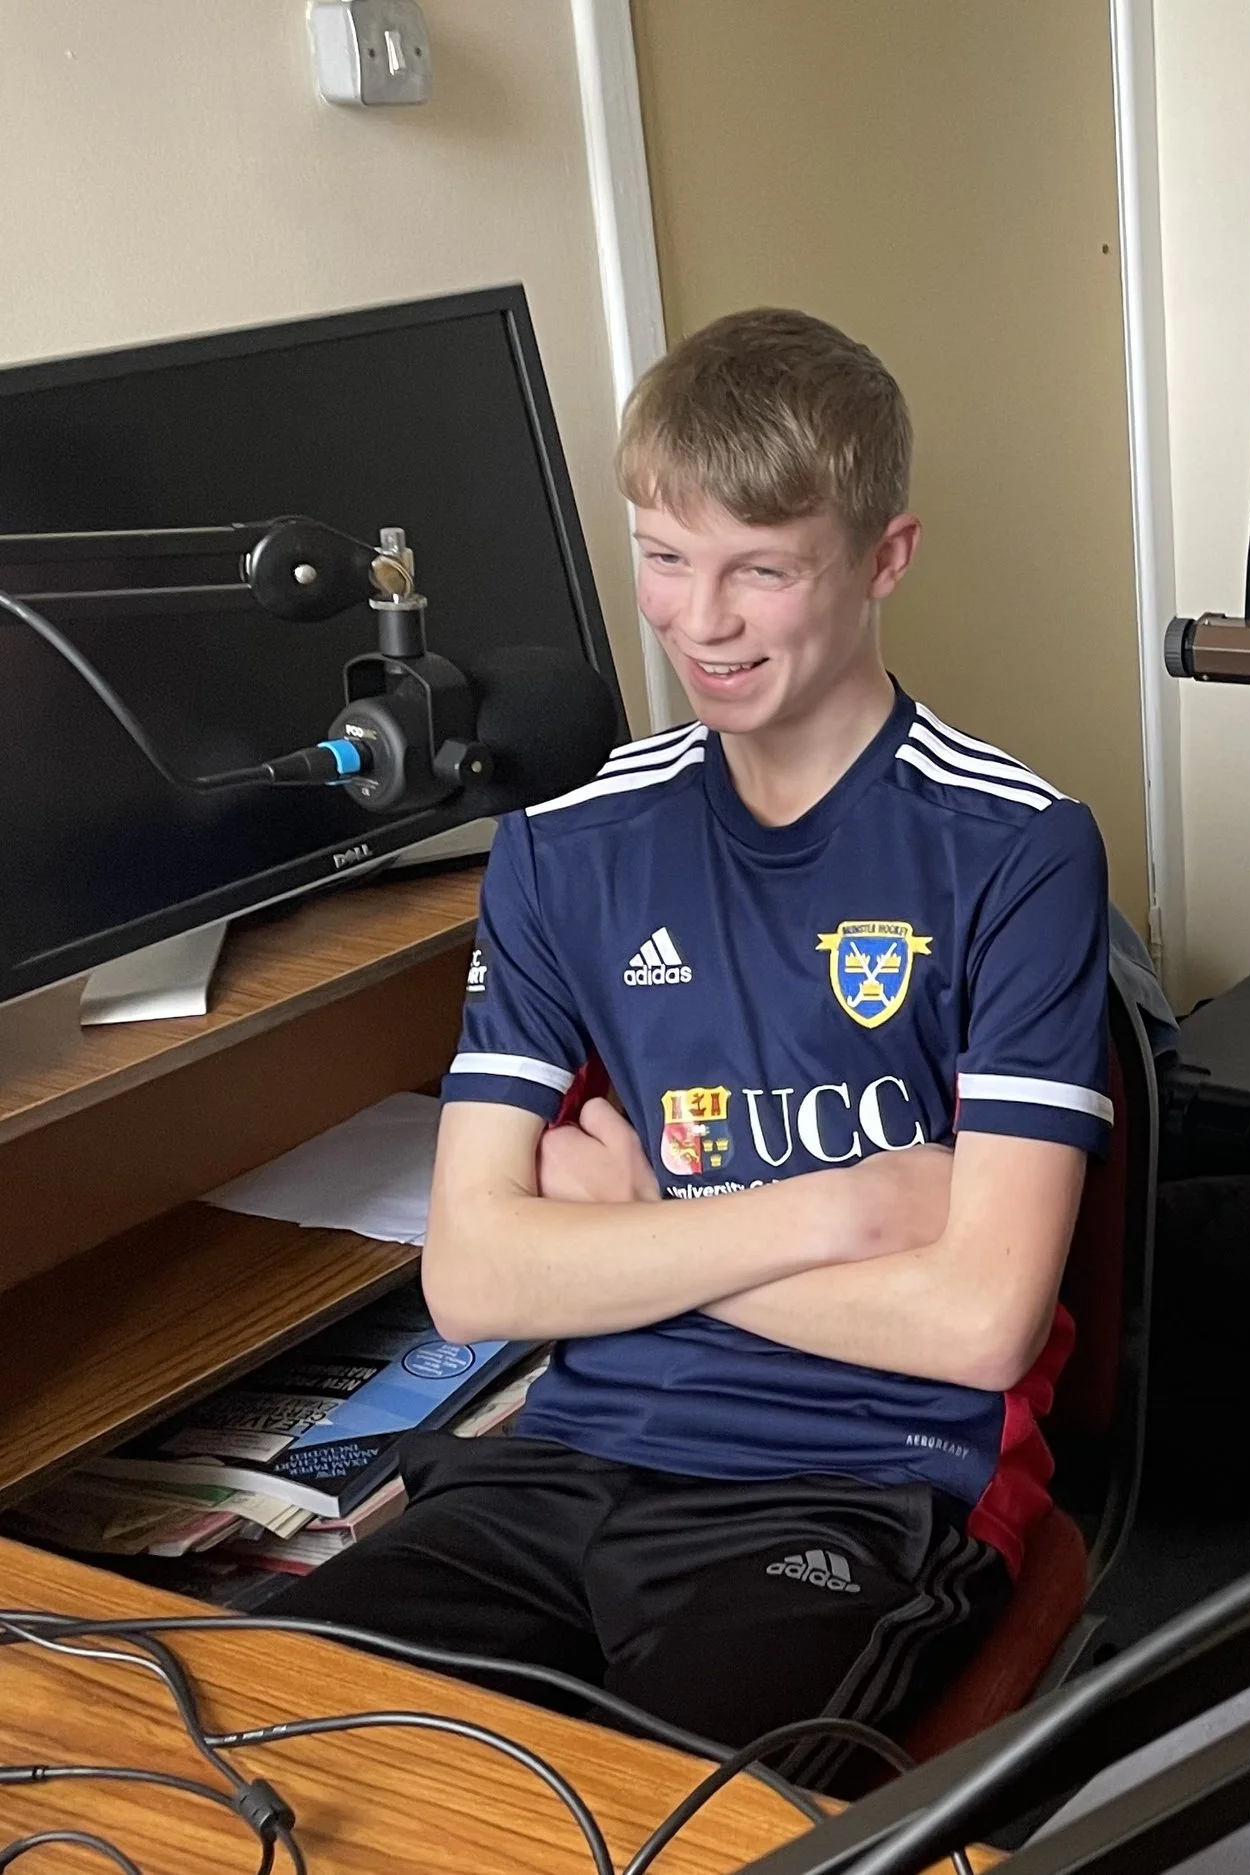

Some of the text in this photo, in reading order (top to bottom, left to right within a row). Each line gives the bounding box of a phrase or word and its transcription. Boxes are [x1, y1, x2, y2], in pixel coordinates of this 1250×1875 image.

[624, 963, 692, 986] adidas
[742, 1076, 925, 1167] UCC
[906, 1434, 970, 1460] AEROREADY
[766, 1562, 861, 1593] adidas
